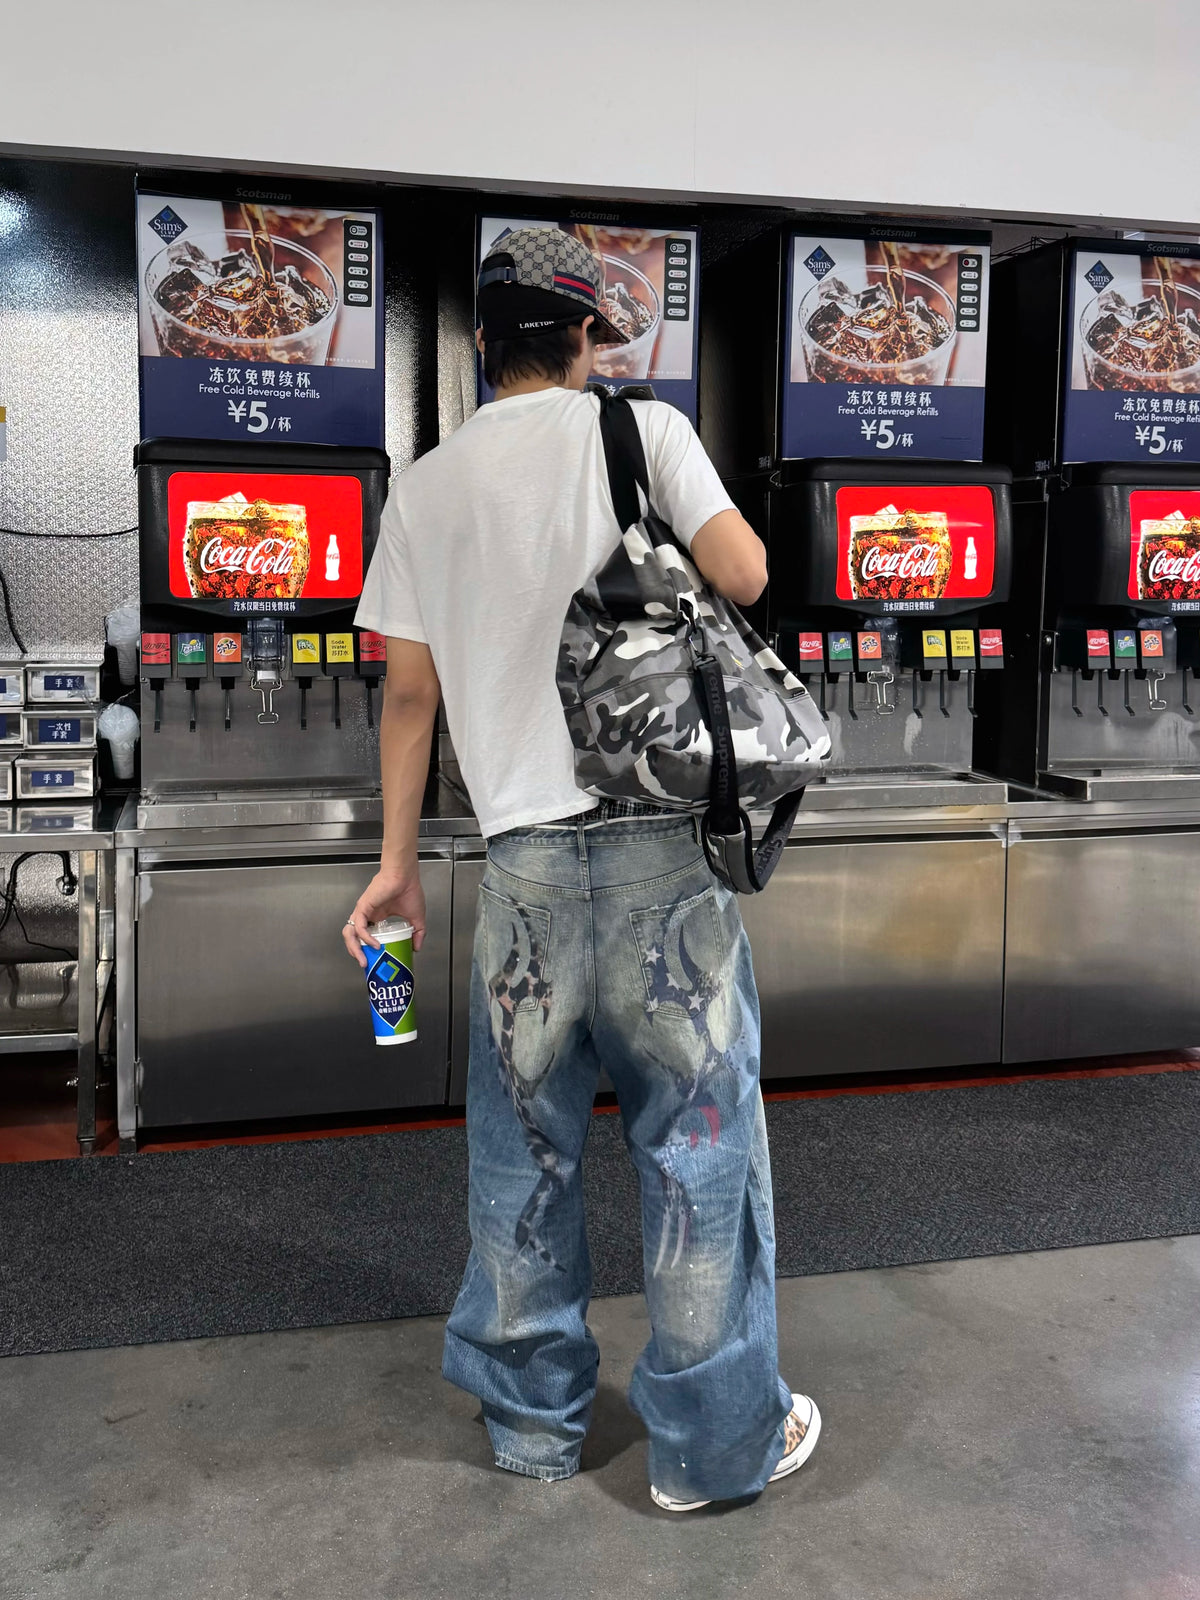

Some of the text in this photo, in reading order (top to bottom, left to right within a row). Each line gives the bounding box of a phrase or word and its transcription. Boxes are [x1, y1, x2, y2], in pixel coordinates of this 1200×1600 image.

[235, 186, 292, 201] Scotsman
[569, 209, 620, 221] Scotsman
[154, 218, 182, 232] Sam's
[870, 227, 917, 238] Scotsman
[1147, 243, 1190, 254] Scotsman
[808, 257, 832, 269] Sam's
[1088, 272, 1110, 283] Sam's
[209, 367, 311, 389] 冻饮免费续杯
[199, 384, 321, 400] Free Cold Beverage Refills
[847, 390, 932, 407] 冻饮免费续杯
[838, 406, 939, 417] Free Cold Beverage Refills
[1114, 412, 1131, 421] Free
[1132, 413, 1150, 422] Cold
[1151, 413, 1185, 424] Beverage
[200, 536, 297, 576] Coca-Cola
[862, 543, 940, 581] Coca-Cola
[48, 722, 71, 731] 一次性
[52, 731, 68, 739] 手套
[43, 774, 63, 784] 手套
[369, 980, 412, 1000] Sam's
[378, 998, 405, 1008] CLUB
